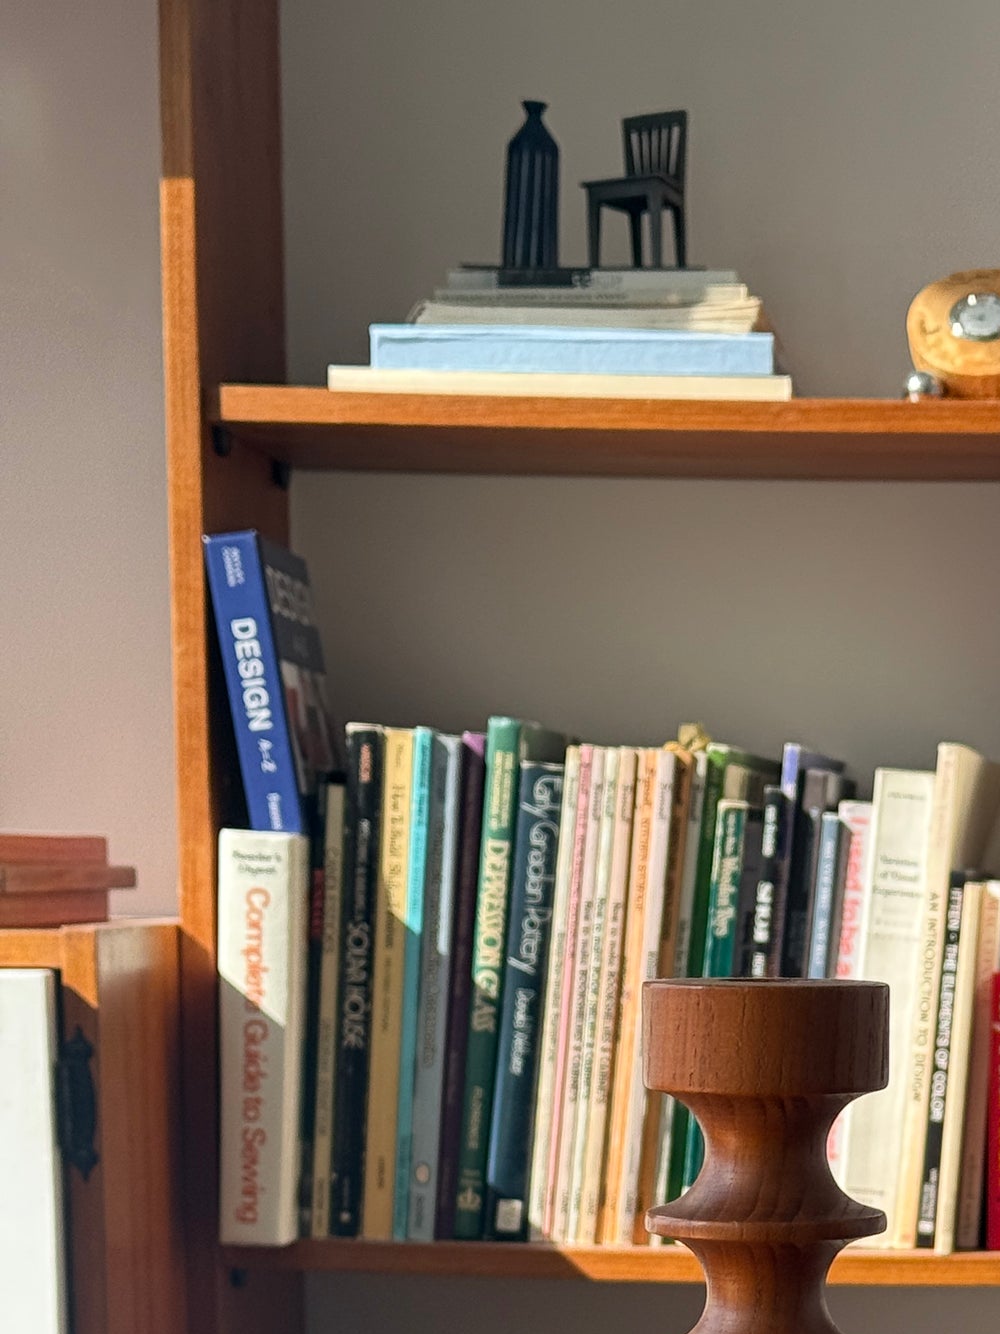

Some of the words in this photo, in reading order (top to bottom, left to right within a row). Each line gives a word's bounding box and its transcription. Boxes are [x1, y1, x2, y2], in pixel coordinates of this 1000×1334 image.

[229, 618, 274, 732] DESIGN
[520, 775, 563, 817] Early
[524, 820, 560, 904] Canadian
[476, 838, 509, 966] DEPRESSION
[929, 892, 941, 912] AN
[241, 887, 271, 1015] Complete
[507, 906, 552, 975] Pottery
[836, 961, 853, 977] a
[920, 917, 939, 1022] INTRODUCTION
[936, 973, 955, 1046] ELEMENTS
[242, 1019, 267, 1092] Guide
[911, 1053, 926, 1103] DESIGN
[934, 1048, 948, 1069] OF
[243, 1096, 266, 1120] to
[930, 1071, 945, 1122] COLOR
[236, 1127, 267, 1224] Sewing
